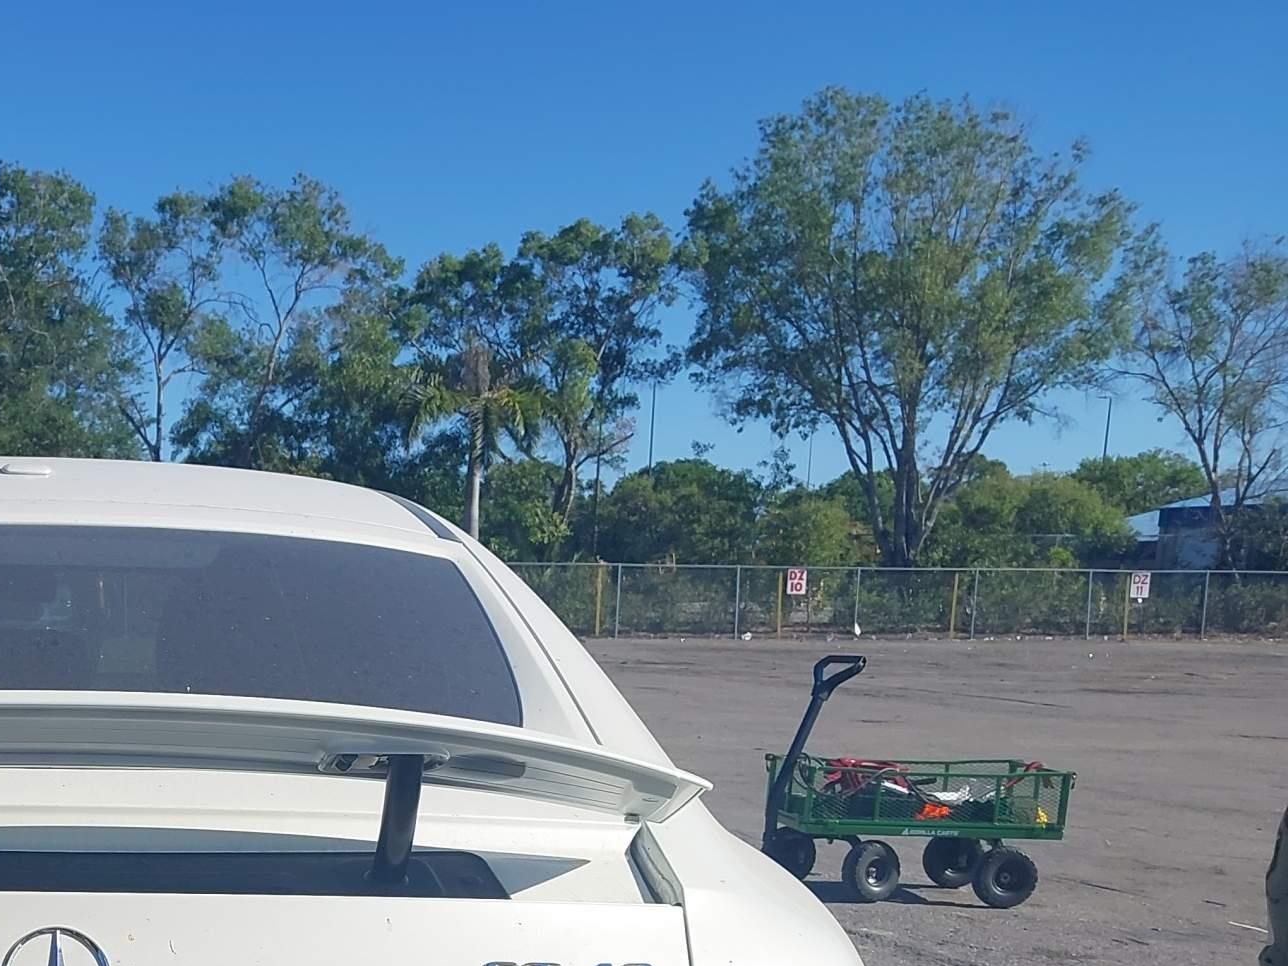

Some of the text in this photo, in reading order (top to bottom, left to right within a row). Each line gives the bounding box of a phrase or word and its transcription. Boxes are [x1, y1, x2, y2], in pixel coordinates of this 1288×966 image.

[789, 570, 805, 581] DZ
[1133, 574, 1149, 585] DZ
[790, 582, 803, 592] 10
[1136, 586, 1143, 596] 11
